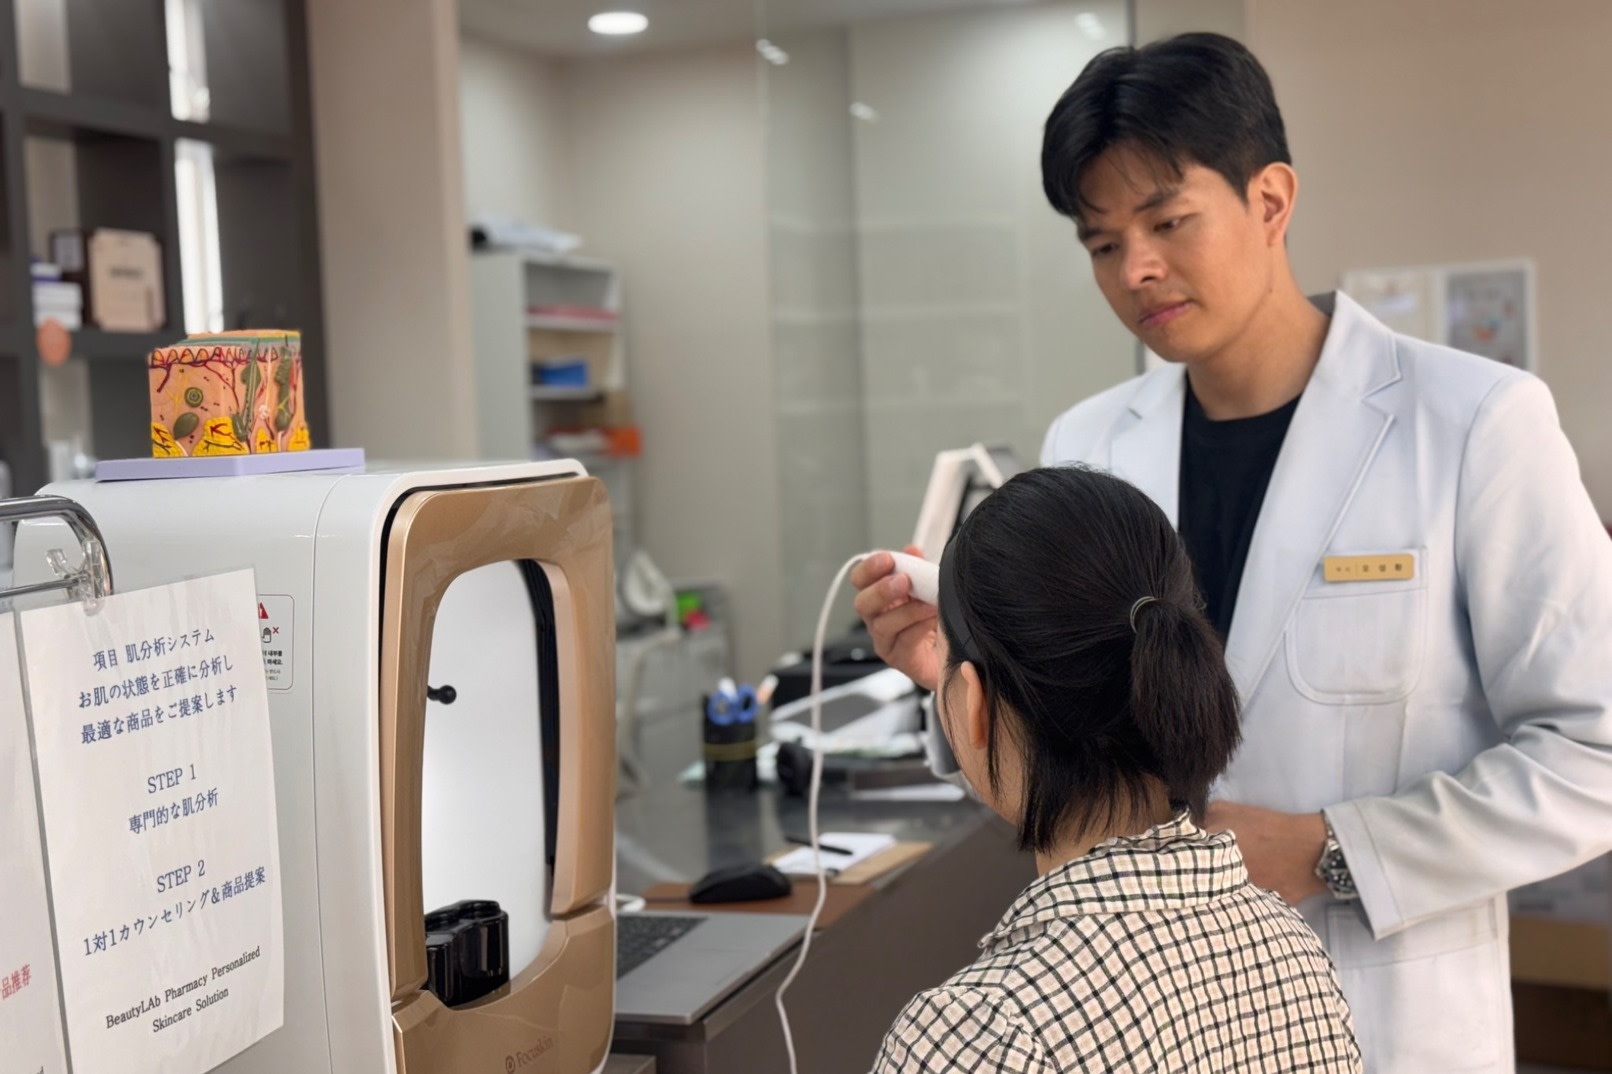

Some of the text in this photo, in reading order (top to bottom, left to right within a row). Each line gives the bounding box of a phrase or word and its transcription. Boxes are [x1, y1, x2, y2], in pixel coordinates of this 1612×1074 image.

[92, 628, 215, 672] 項目 肌分析システム
[78, 654, 234, 709] お肌の状態を正確に分析し
[80, 684, 237, 745] 最適な商品をご提案します
[147, 763, 197, 795] STEP 1
[128, 786, 219, 835] 専門的な肌分析
[156, 859, 206, 894] STEP 2
[0, 963, 32, 1000] 品推荐
[105, 945, 261, 1030] BeautyLAb Pharmacy Personalized
[152, 987, 230, 1033] Skincare Solution
